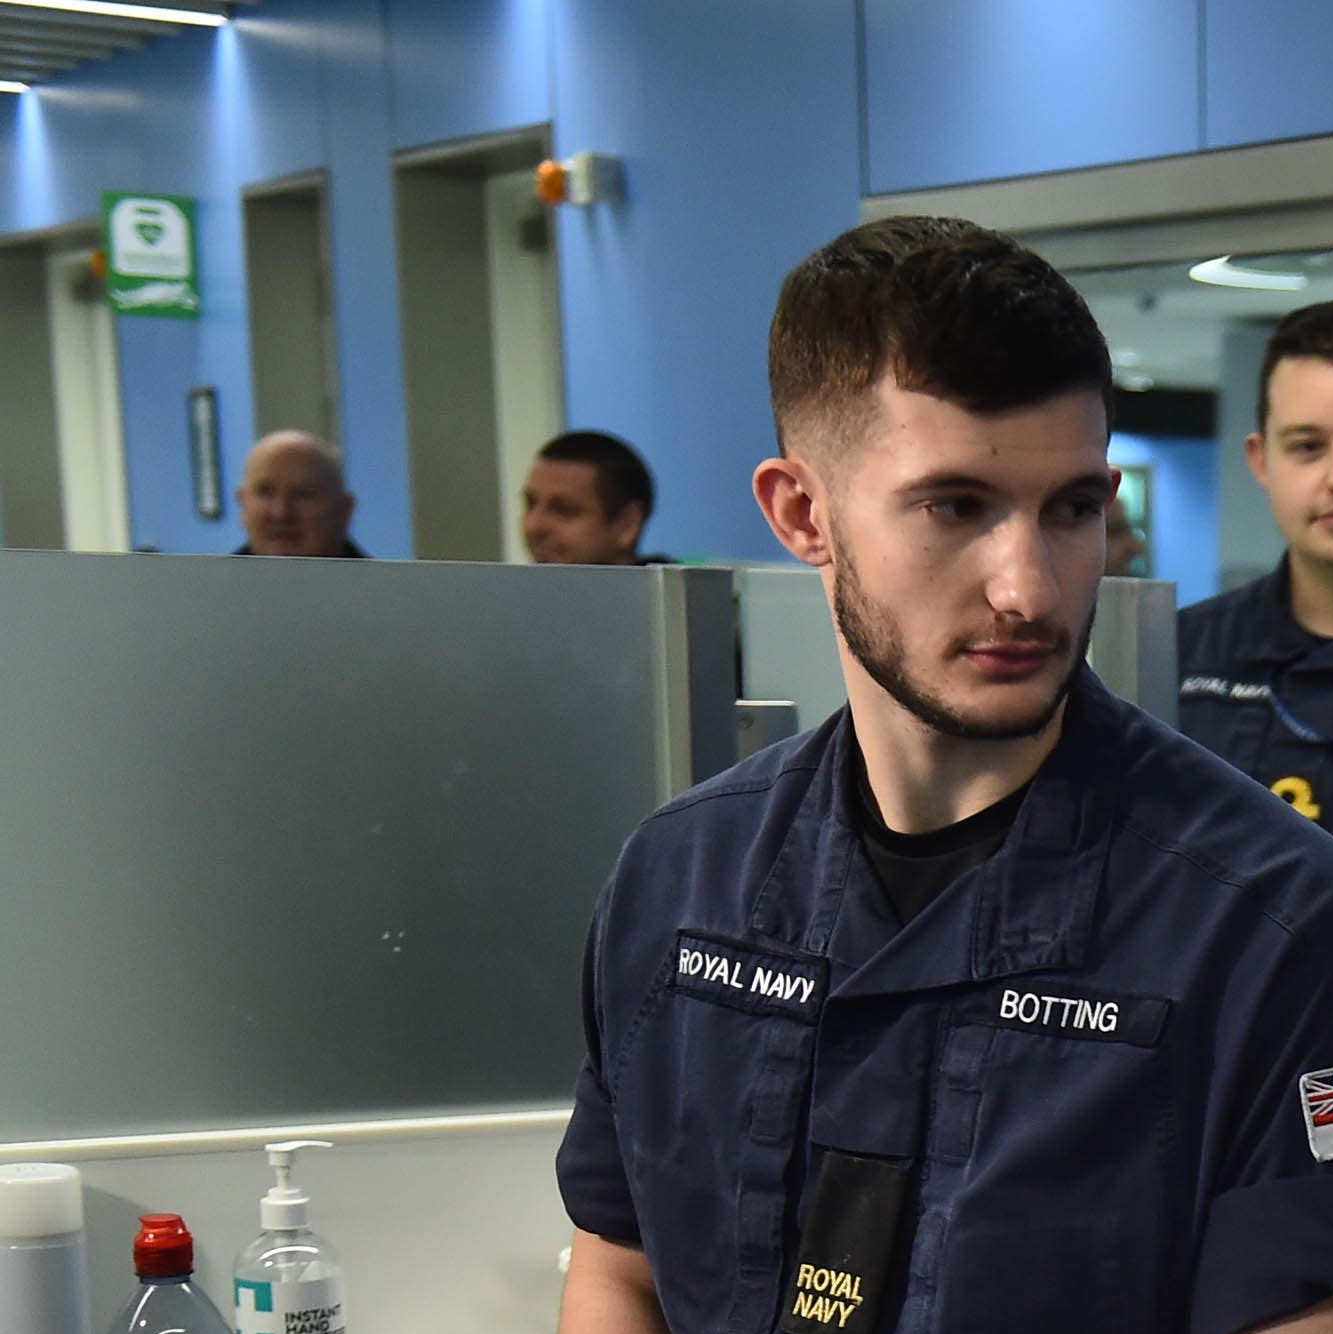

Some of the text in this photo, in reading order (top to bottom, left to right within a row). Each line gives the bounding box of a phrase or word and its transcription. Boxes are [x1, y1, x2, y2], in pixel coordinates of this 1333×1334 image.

[679, 948, 816, 1004] ROYAL NAVY
[1000, 989, 1119, 1033] BOTTING
[797, 1263, 864, 1306] ROYAL
[792, 1291, 856, 1328] NAVY
